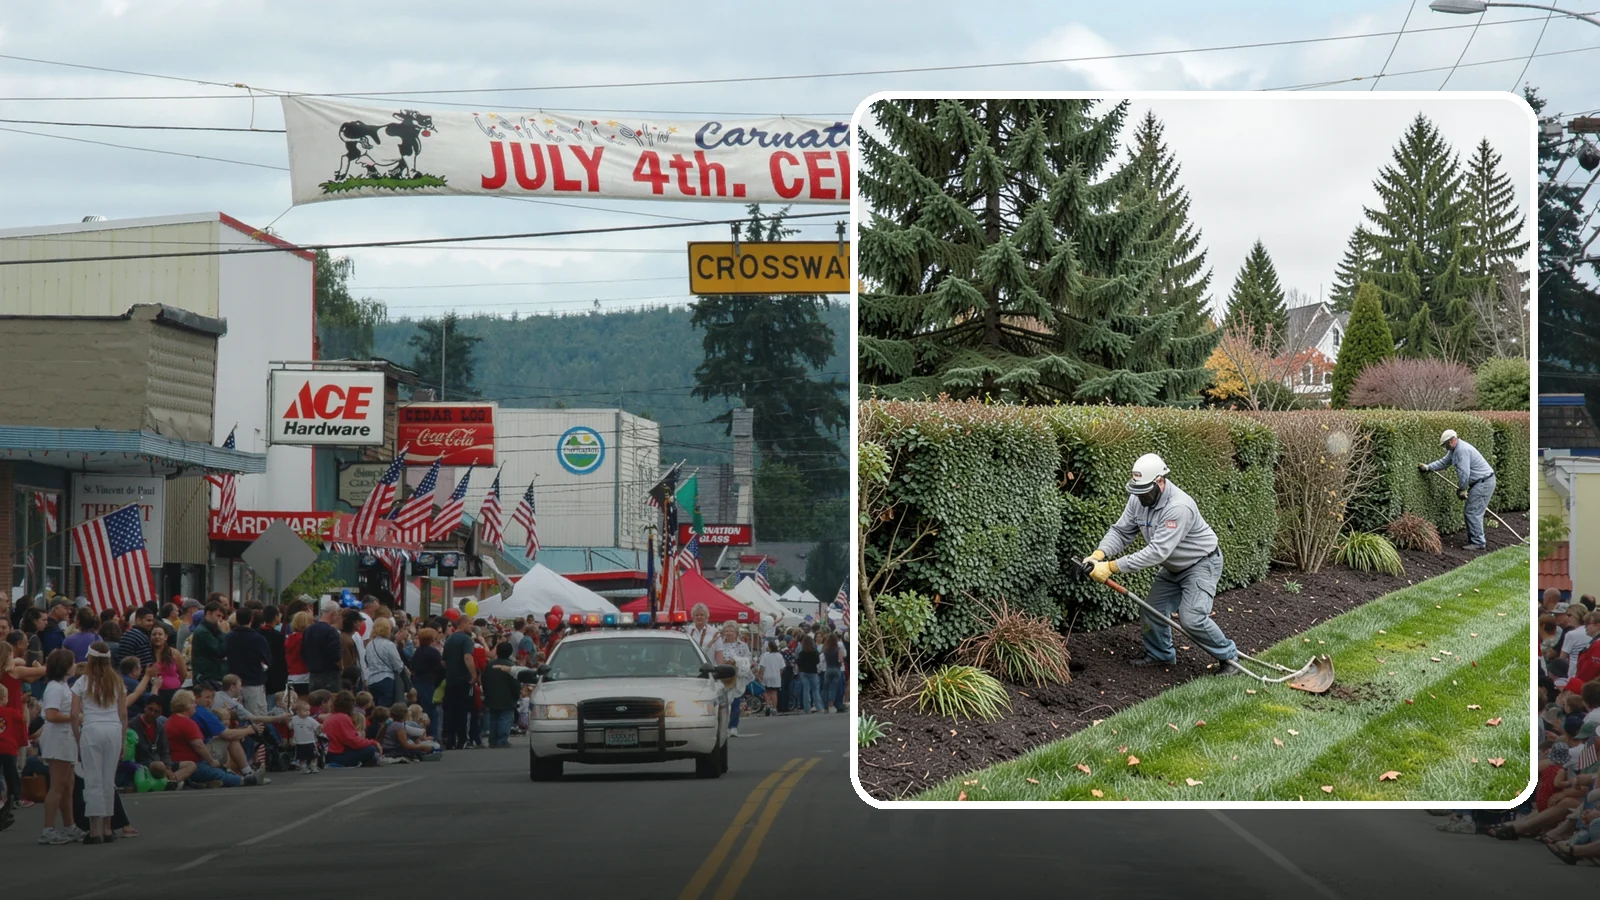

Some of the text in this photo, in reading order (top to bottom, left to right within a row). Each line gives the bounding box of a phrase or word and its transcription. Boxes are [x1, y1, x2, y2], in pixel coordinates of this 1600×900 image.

[695, 121, 850, 150] Carnat
[481, 140, 605, 192] JULY
[632, 150, 747, 198] 4th.
[697, 254, 850, 280] CROSSWA
[282, 380, 374, 420] ACE
[405, 409, 453, 422] CEDAR
[283, 421, 370, 436] Hardware
[416, 427, 477, 447] Coca-Cola
[353, 467, 386, 480] Simpl
[96, 485, 123, 494] Vincent
[126, 486, 135, 494] de
[137, 486, 155, 495] Paul
[688, 526, 741, 535] CRNATION
[699, 535, 730, 543] GLASS
